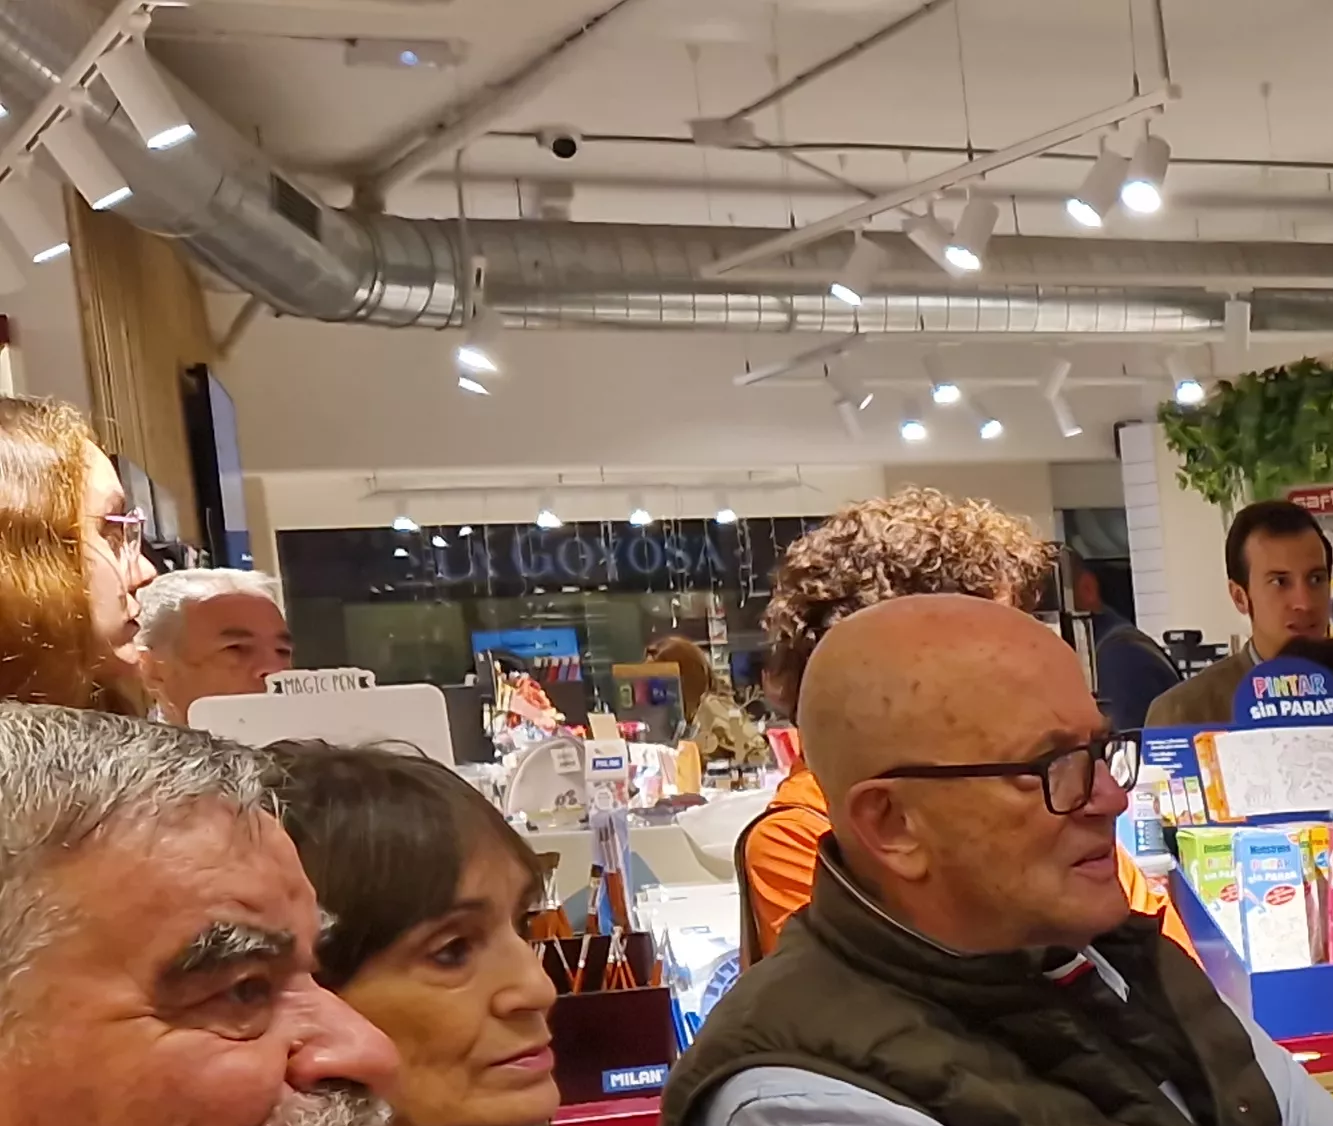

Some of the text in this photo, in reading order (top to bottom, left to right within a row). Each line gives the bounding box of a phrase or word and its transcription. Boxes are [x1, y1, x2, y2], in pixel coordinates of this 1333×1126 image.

[512, 532, 726, 581] GOYOSA
[283, 674, 356, 695] MAGIC PEN
[1252, 673, 1328, 699] PINTAR
[1250, 701, 1278, 719] sin
[610, 1068, 663, 1088] MILAN
